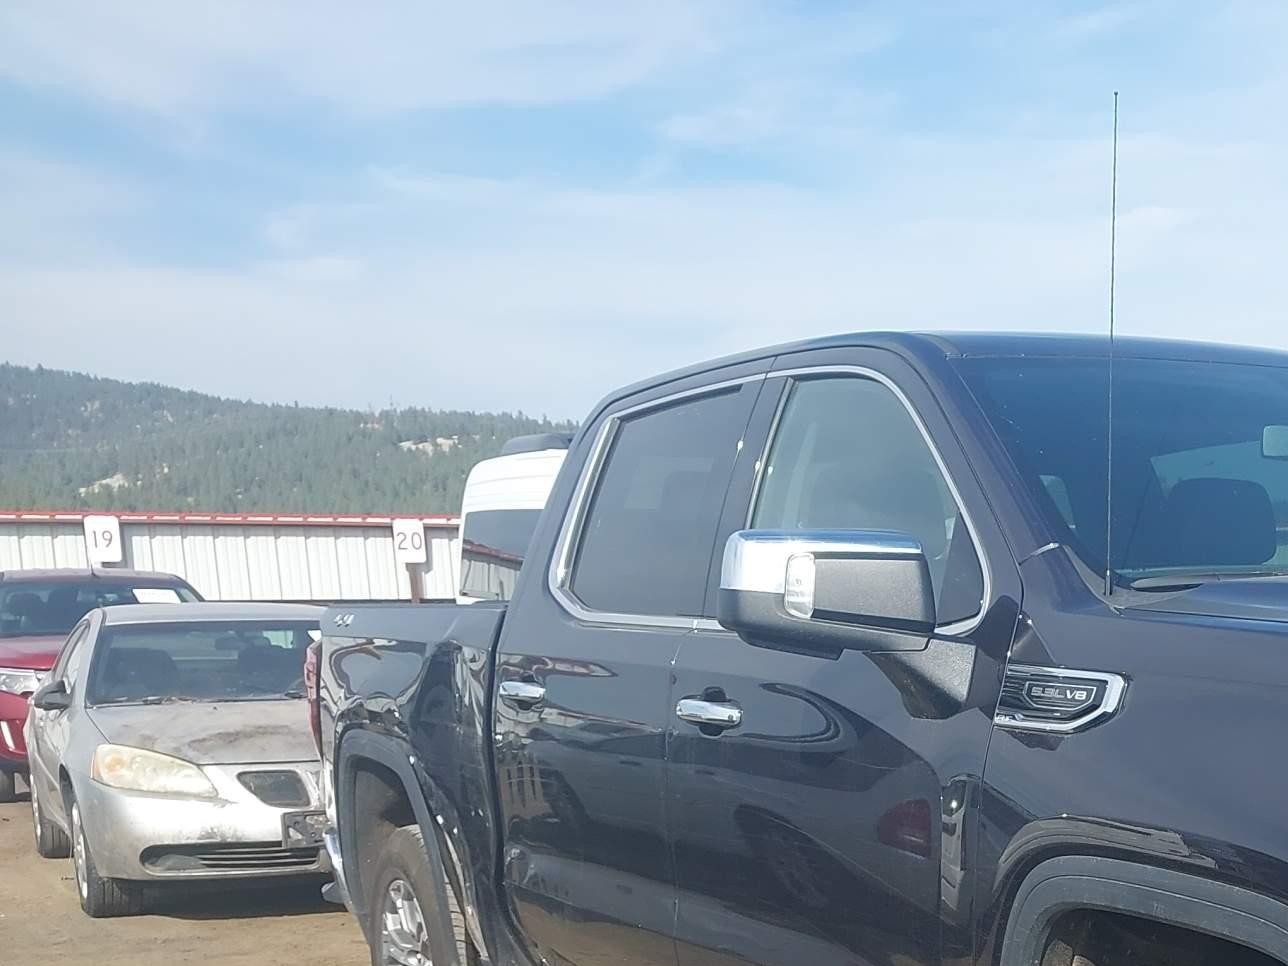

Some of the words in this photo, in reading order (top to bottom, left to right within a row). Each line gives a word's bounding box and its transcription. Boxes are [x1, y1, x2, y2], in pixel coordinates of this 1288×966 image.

[92, 530, 113, 548] 19
[396, 531, 422, 550] 20
[1066, 689, 1087, 700] V8
